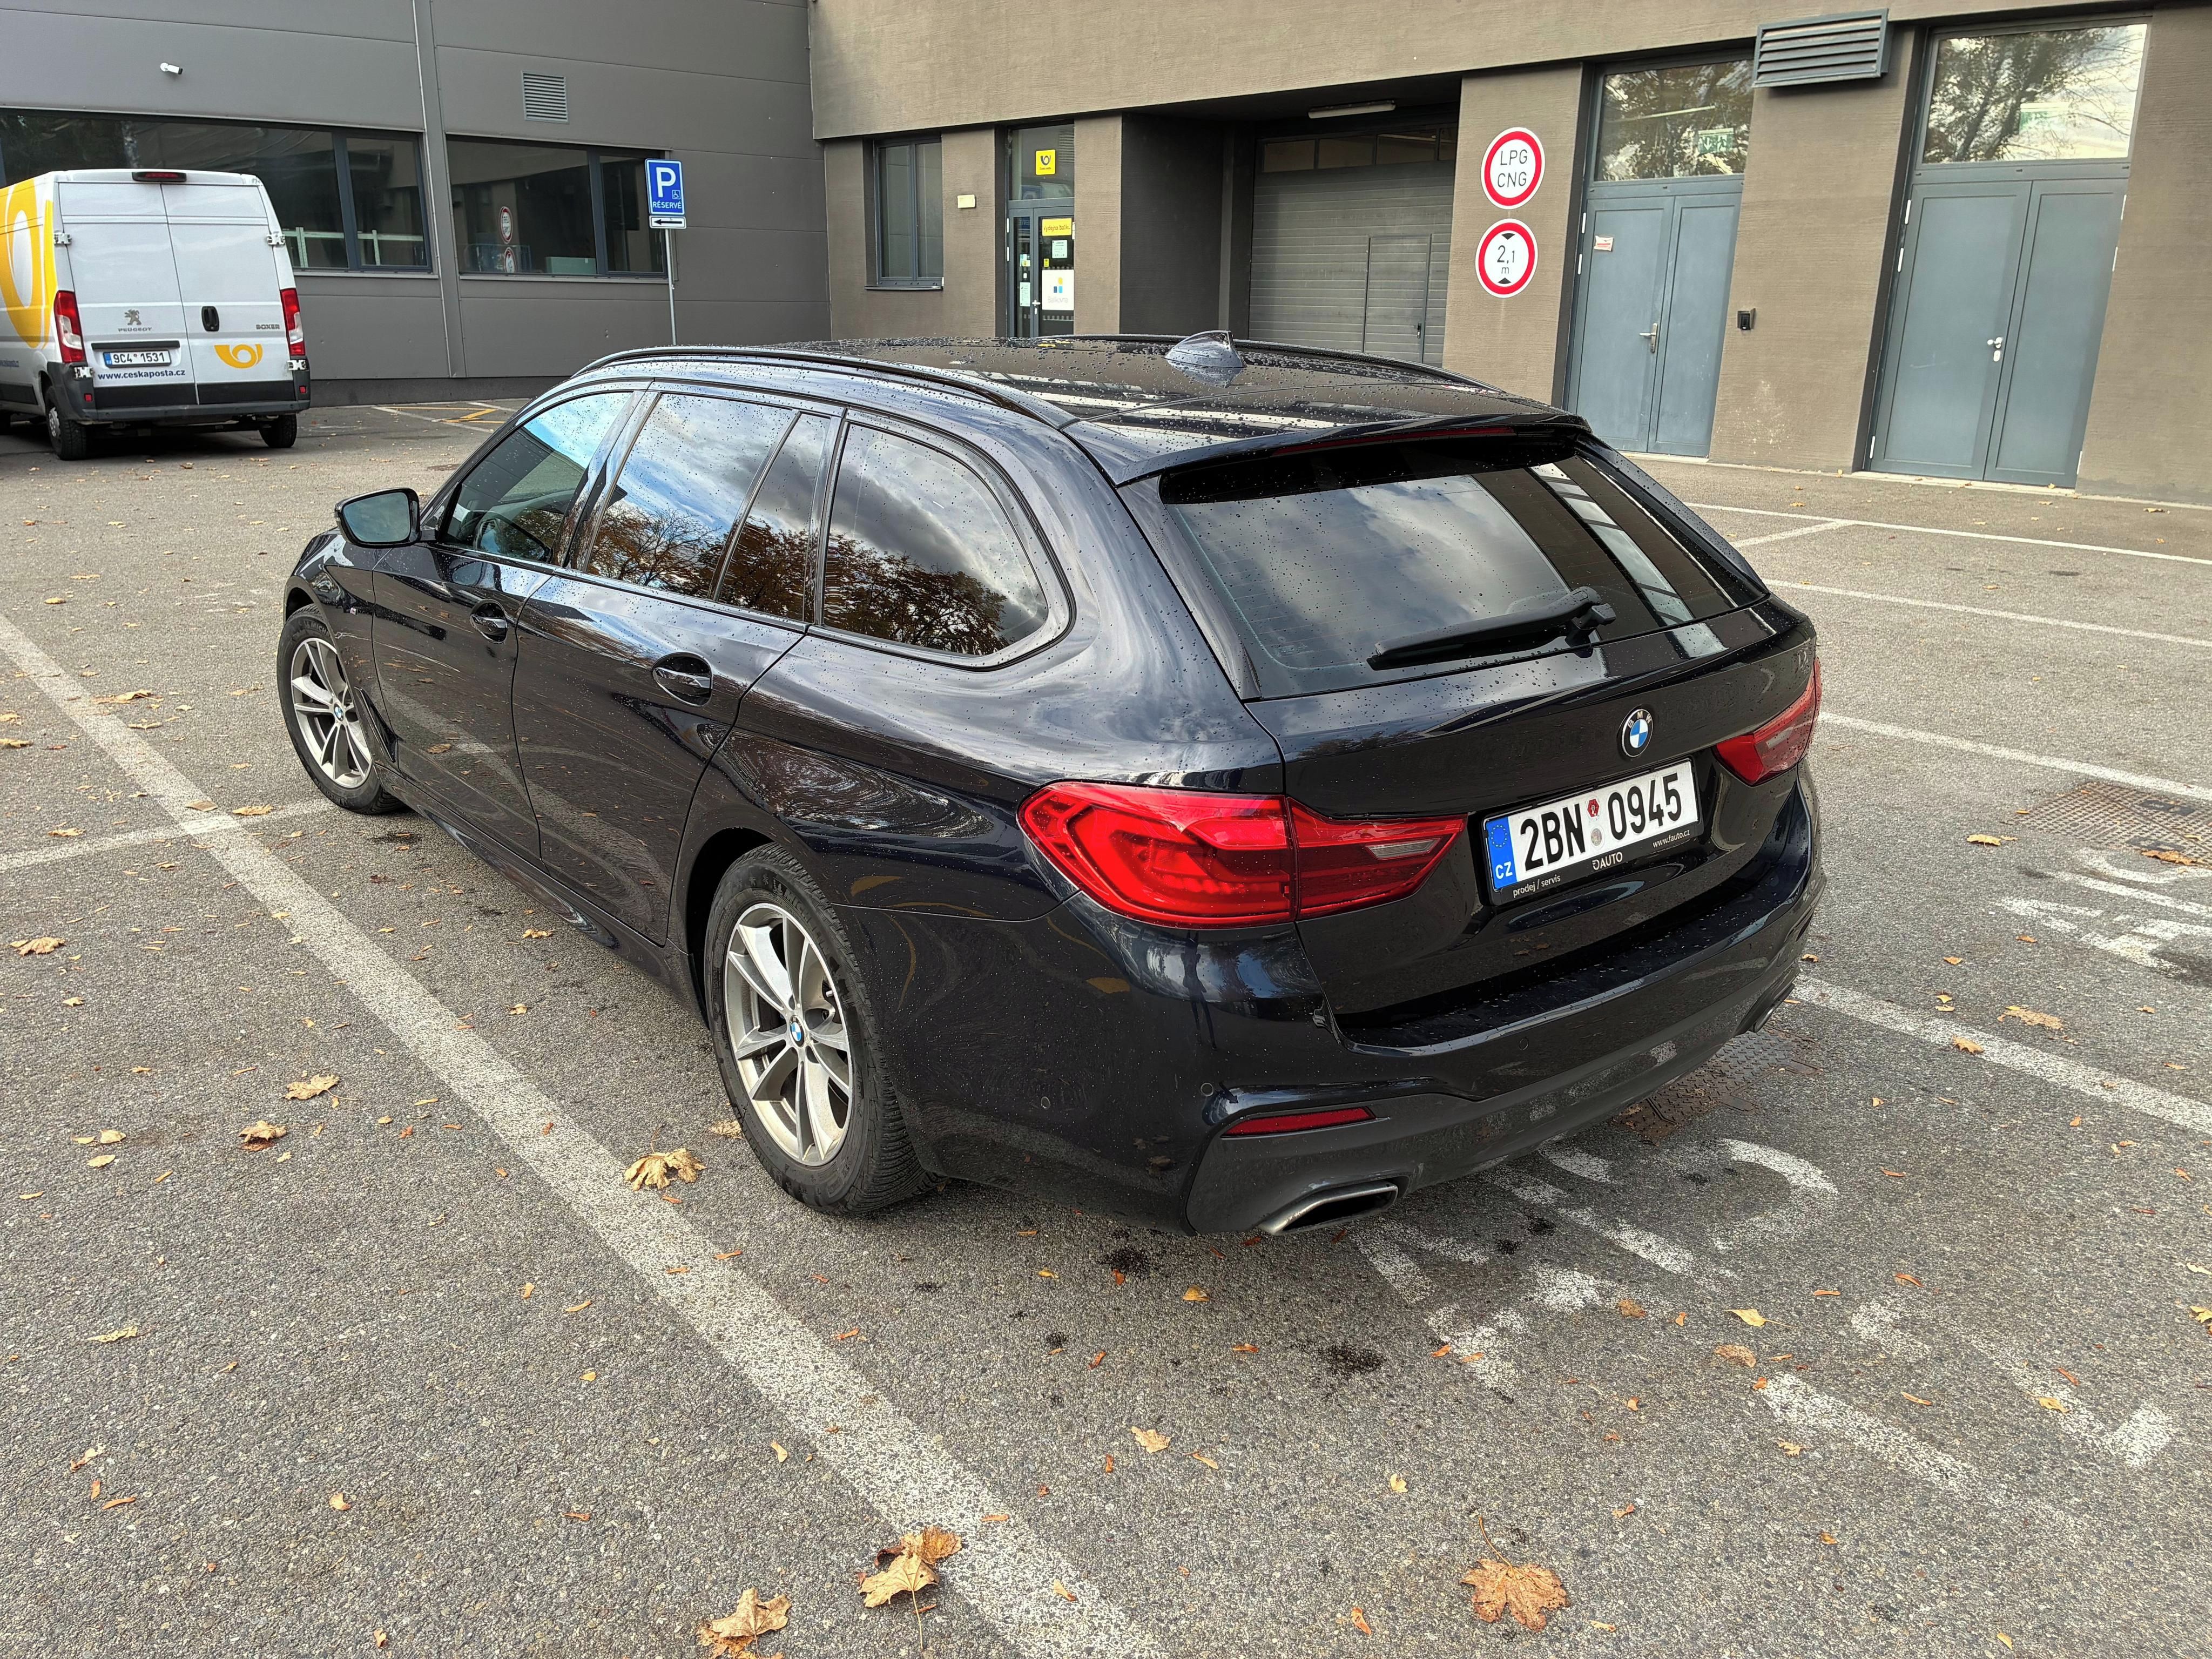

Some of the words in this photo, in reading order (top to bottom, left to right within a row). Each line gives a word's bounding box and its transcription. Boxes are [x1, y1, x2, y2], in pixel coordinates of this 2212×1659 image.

[1500, 149, 1528, 166] LPG
[656, 167, 676, 198] P
[1498, 171, 1527, 187] CNG
[652, 200, 682, 209] RÉSERVÉ
[1496, 245, 1515, 265] 2,1
[1501, 266, 1510, 274] m
[113, 353, 133, 363] 9C4
[140, 352, 165, 362] 1531
[97, 369, 186, 380] www.ceskaposta.cz
[1627, 711, 1652, 729] BMW
[1520, 803, 1586, 871] 2BN
[1607, 773, 1682, 841] 0945
[1652, 830, 1691, 848] www.fauto.cz
[1495, 861, 1513, 879] CZ
[1513, 881, 1535, 898] prodej
[1541, 874, 1561, 887] servis
